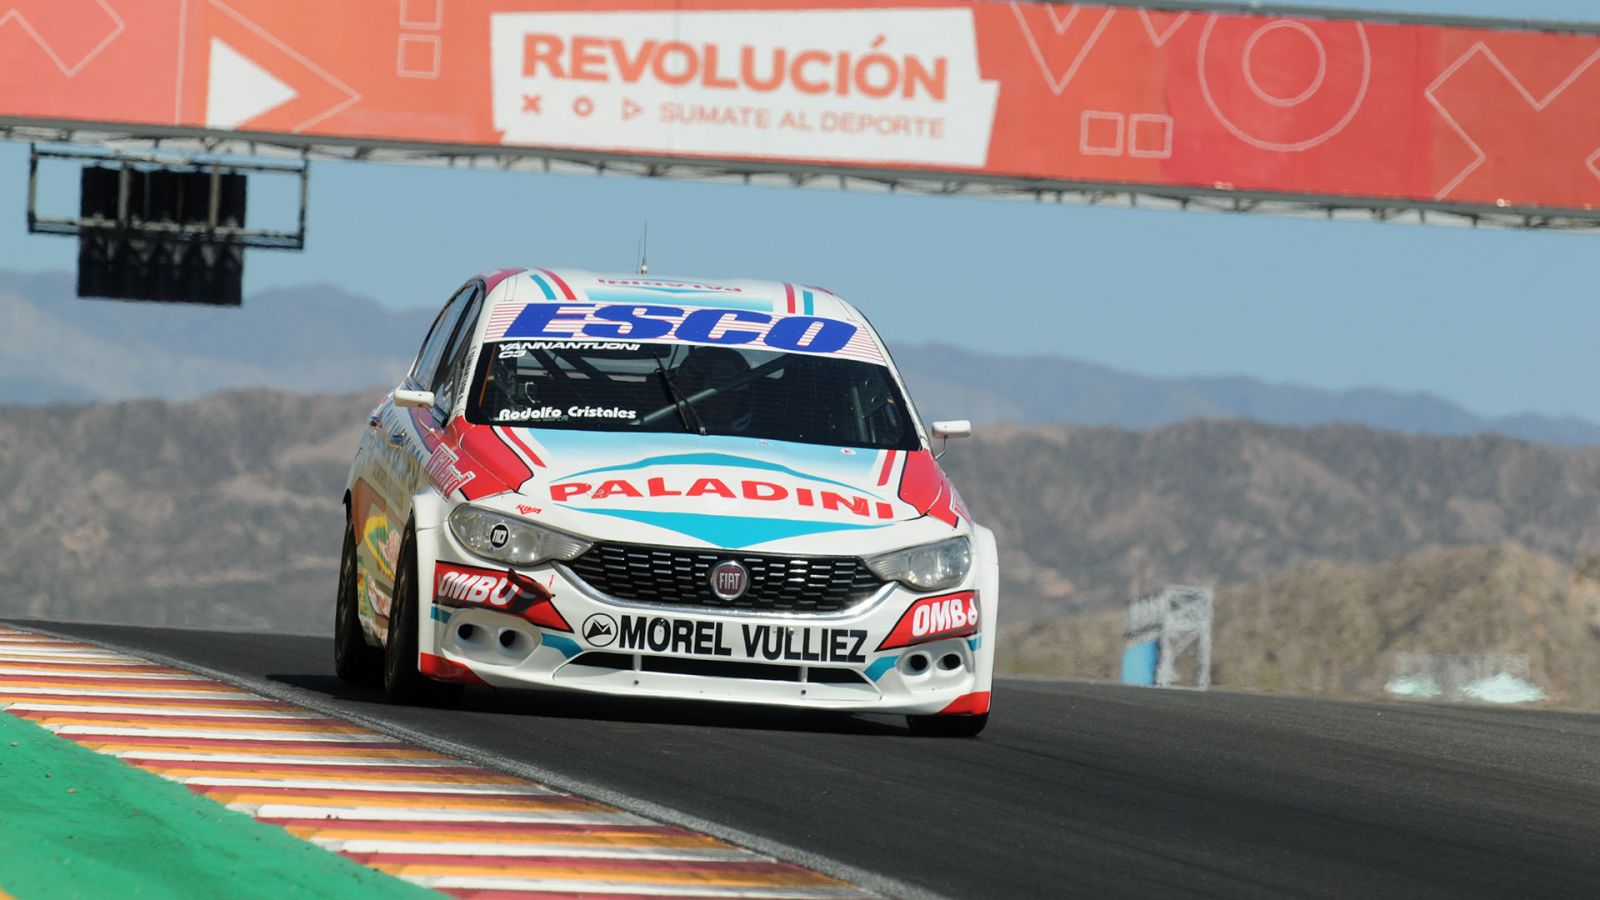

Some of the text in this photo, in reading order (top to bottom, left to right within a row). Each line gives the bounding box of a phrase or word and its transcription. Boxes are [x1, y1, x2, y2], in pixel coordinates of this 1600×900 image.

[521, 33, 948, 102] REVOLUCIÓN
[658, 101, 945, 139] SUMATE AL DEPORTE
[498, 341, 641, 351] YANNANTUONI
[502, 302, 858, 354] ESCO
[499, 406, 637, 421] Rodolfo Cristales
[550, 477, 894, 520] PALADINI
[719, 572, 741, 590] FIAT
[618, 614, 869, 664] MOREL VULLIEZ
